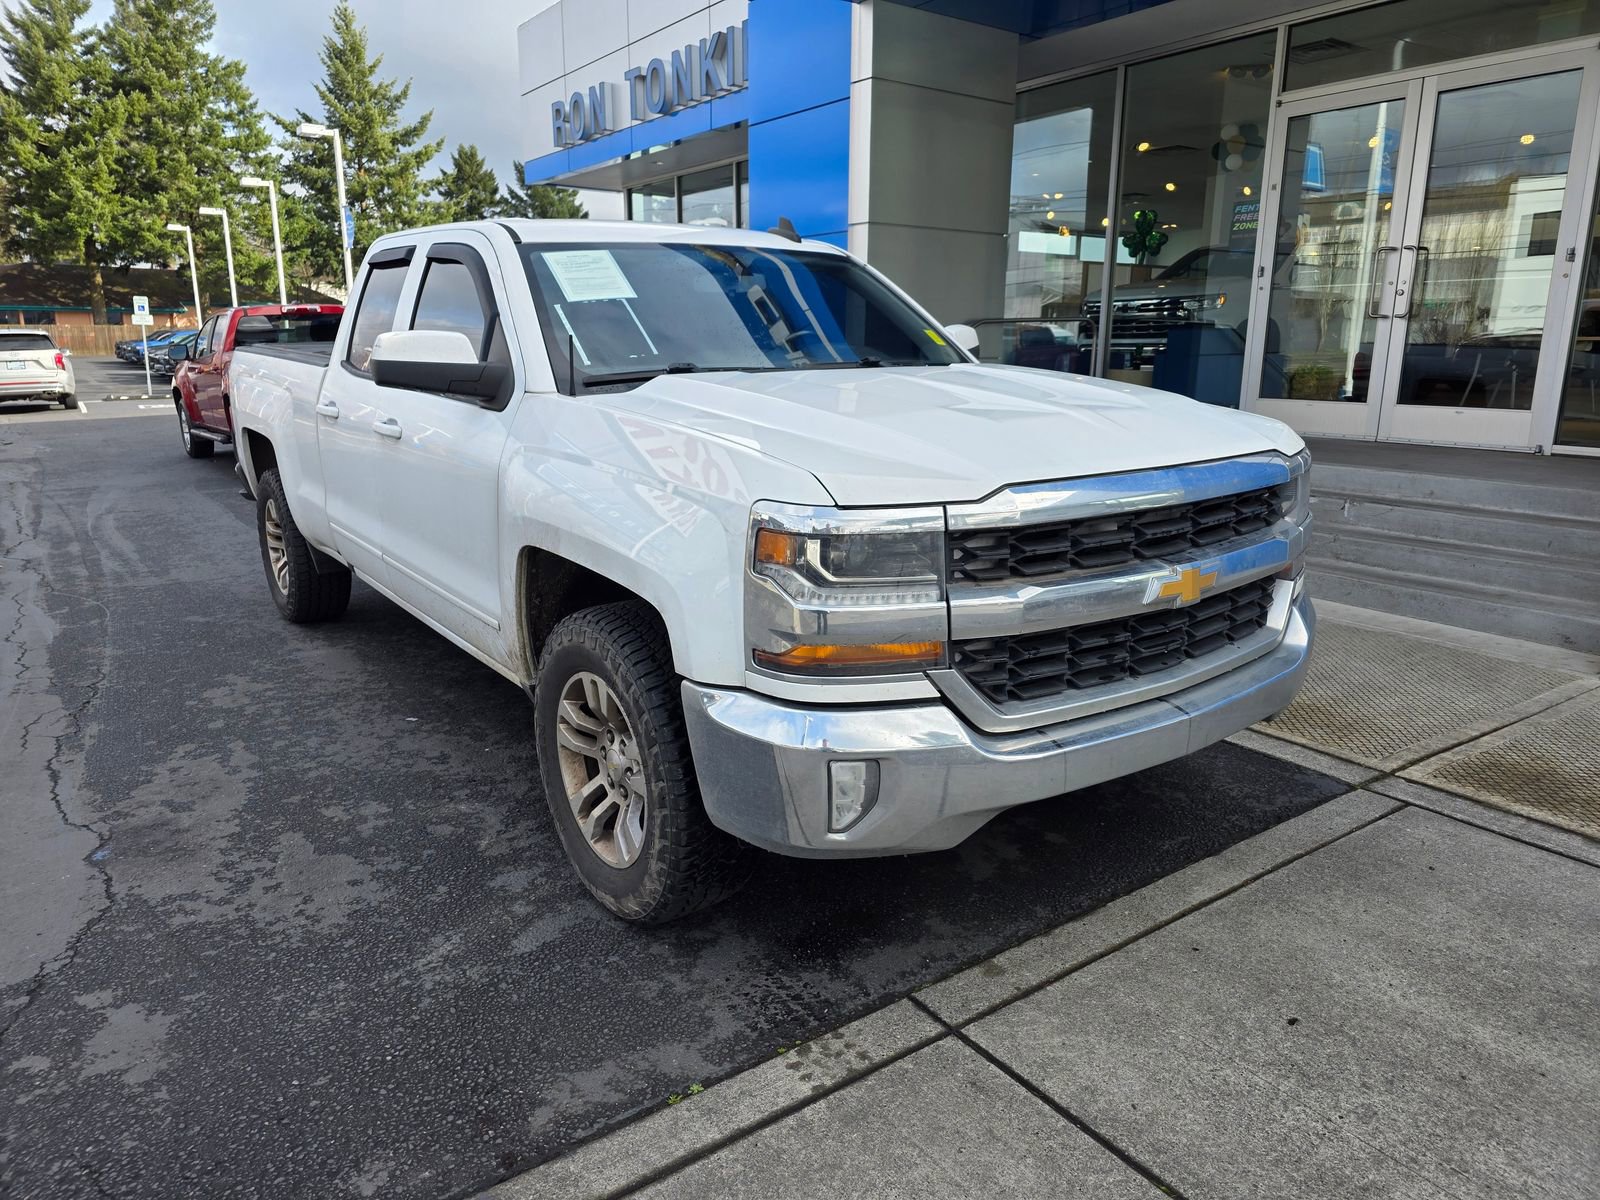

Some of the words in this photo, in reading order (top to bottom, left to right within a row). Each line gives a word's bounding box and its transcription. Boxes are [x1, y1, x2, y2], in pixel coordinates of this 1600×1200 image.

[551, 82, 612, 148] RON
[1233, 212, 1259, 222] FREE
[1232, 221, 1259, 231] ZONE
